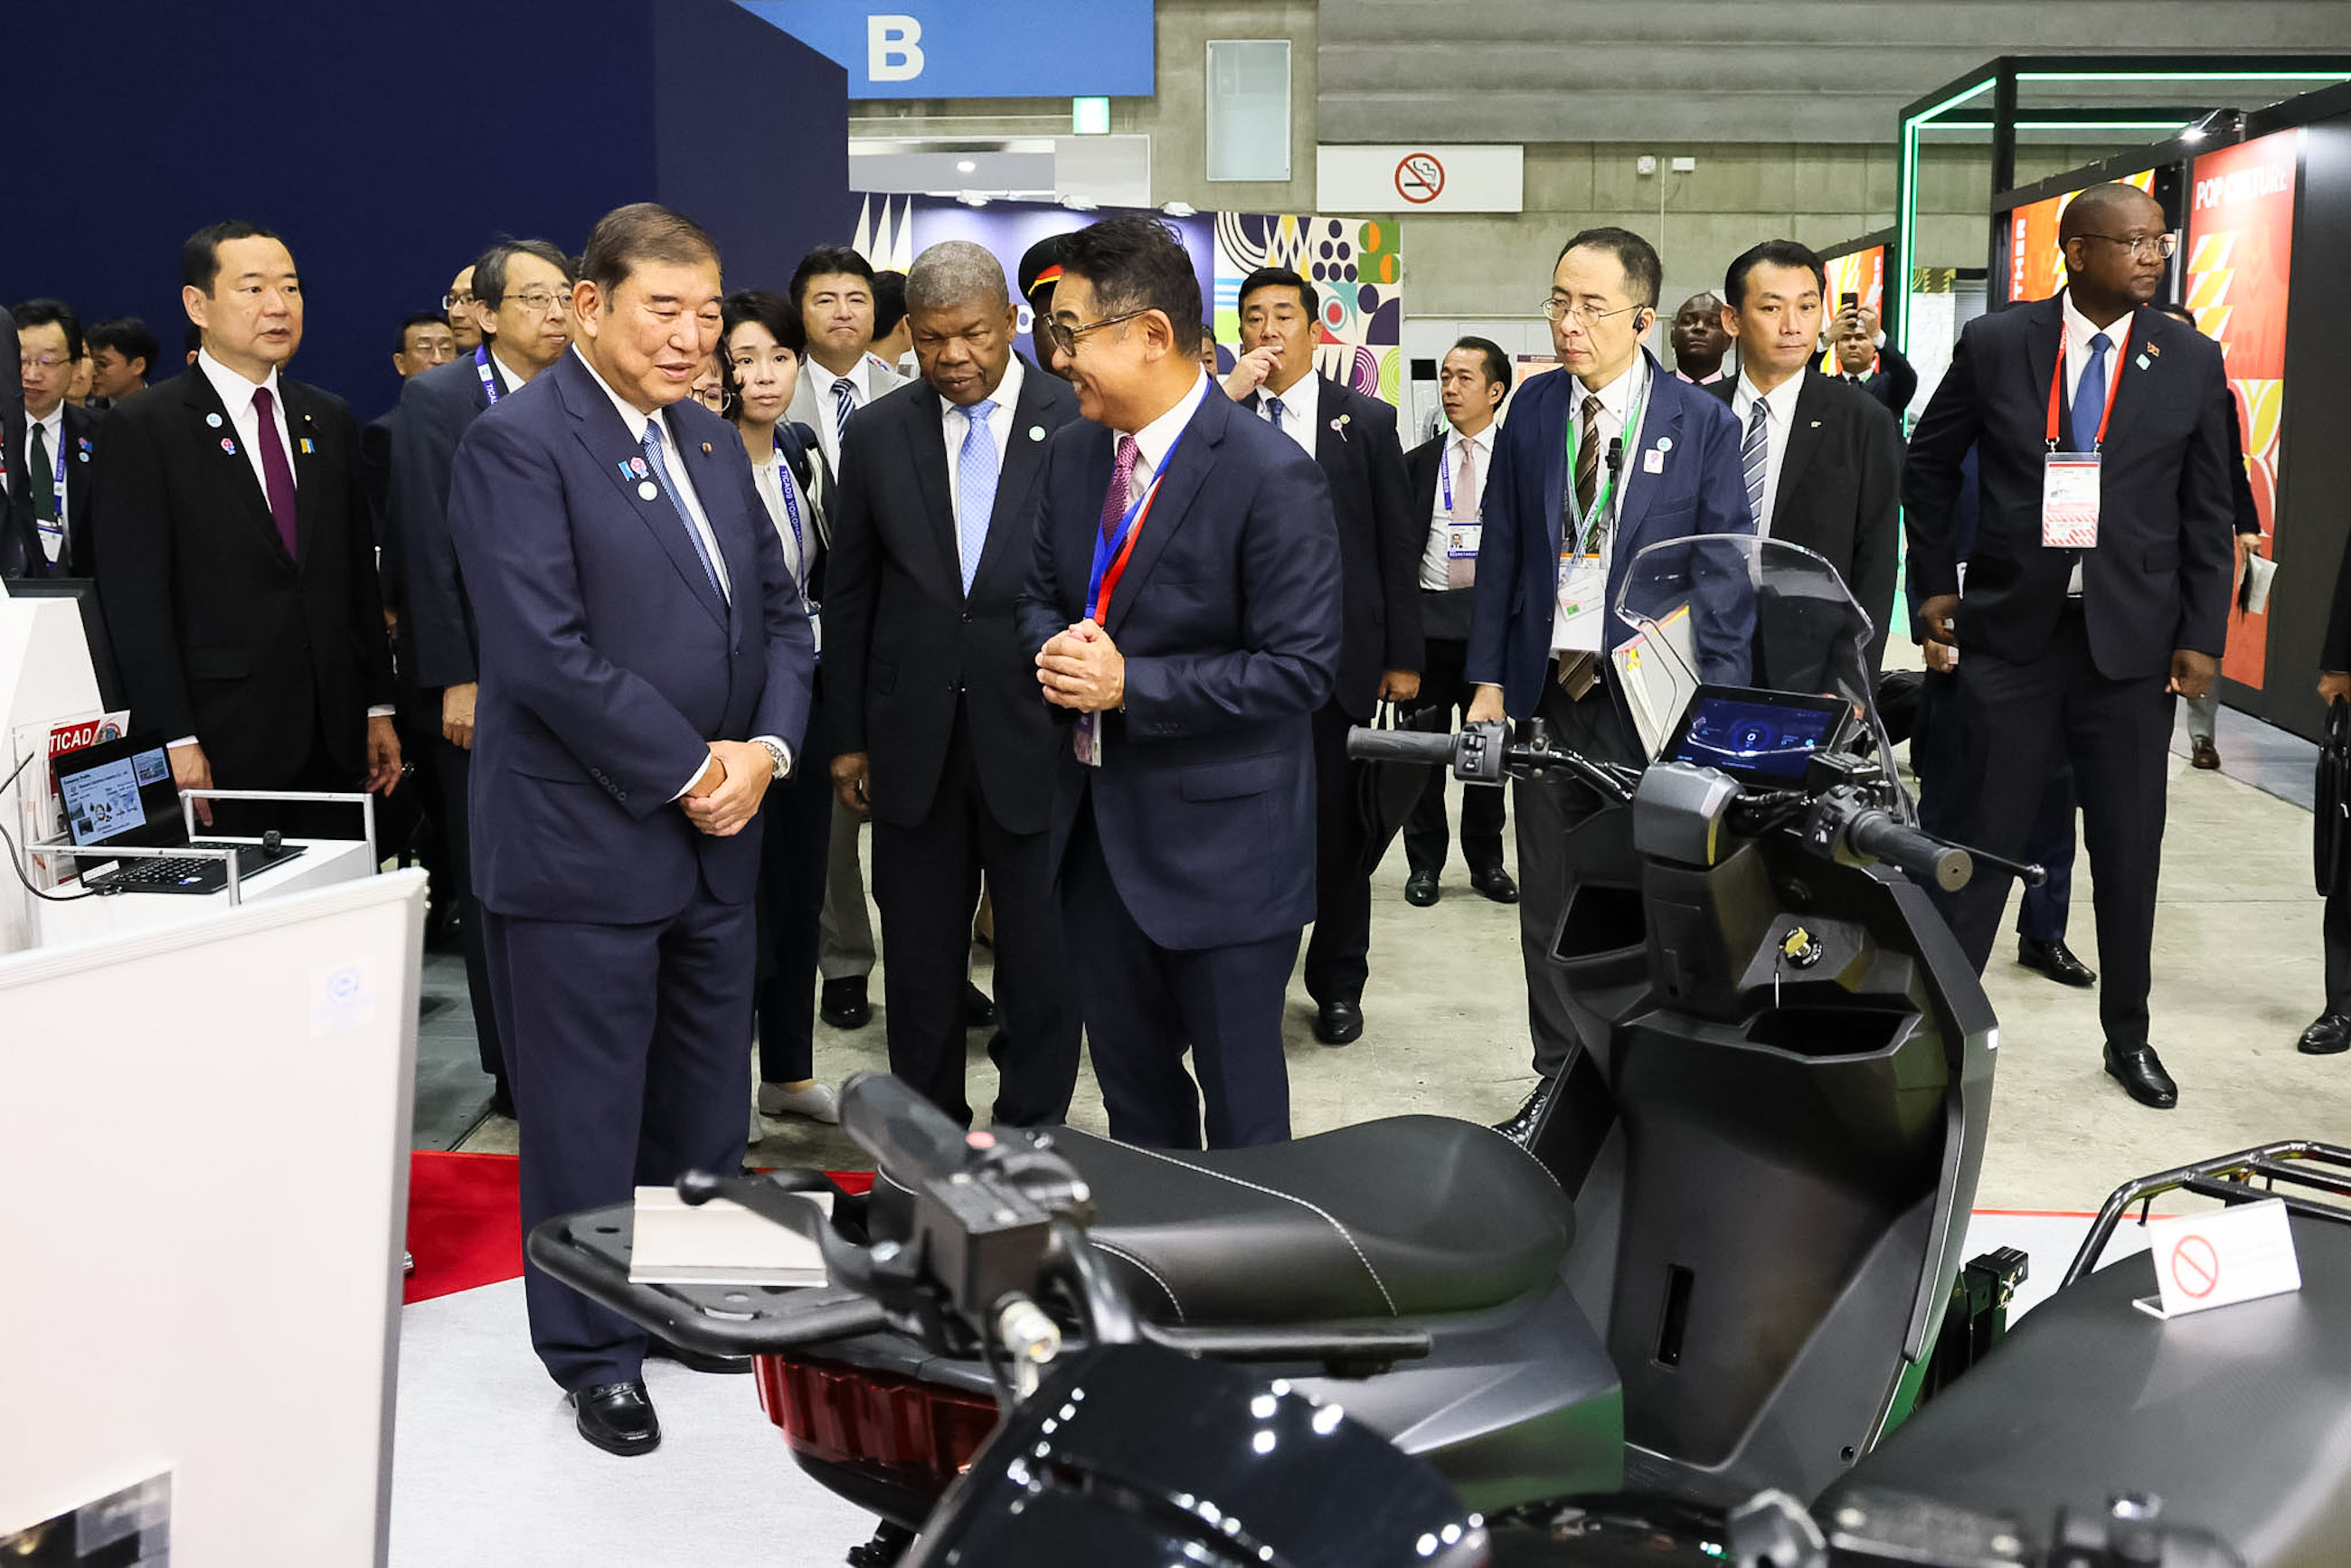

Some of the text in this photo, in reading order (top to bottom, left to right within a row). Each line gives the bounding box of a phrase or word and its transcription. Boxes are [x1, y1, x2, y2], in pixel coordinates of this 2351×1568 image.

[868, 14, 924, 81] B
[2195, 176, 2224, 211] POP
[50, 728, 92, 752] TICAD
